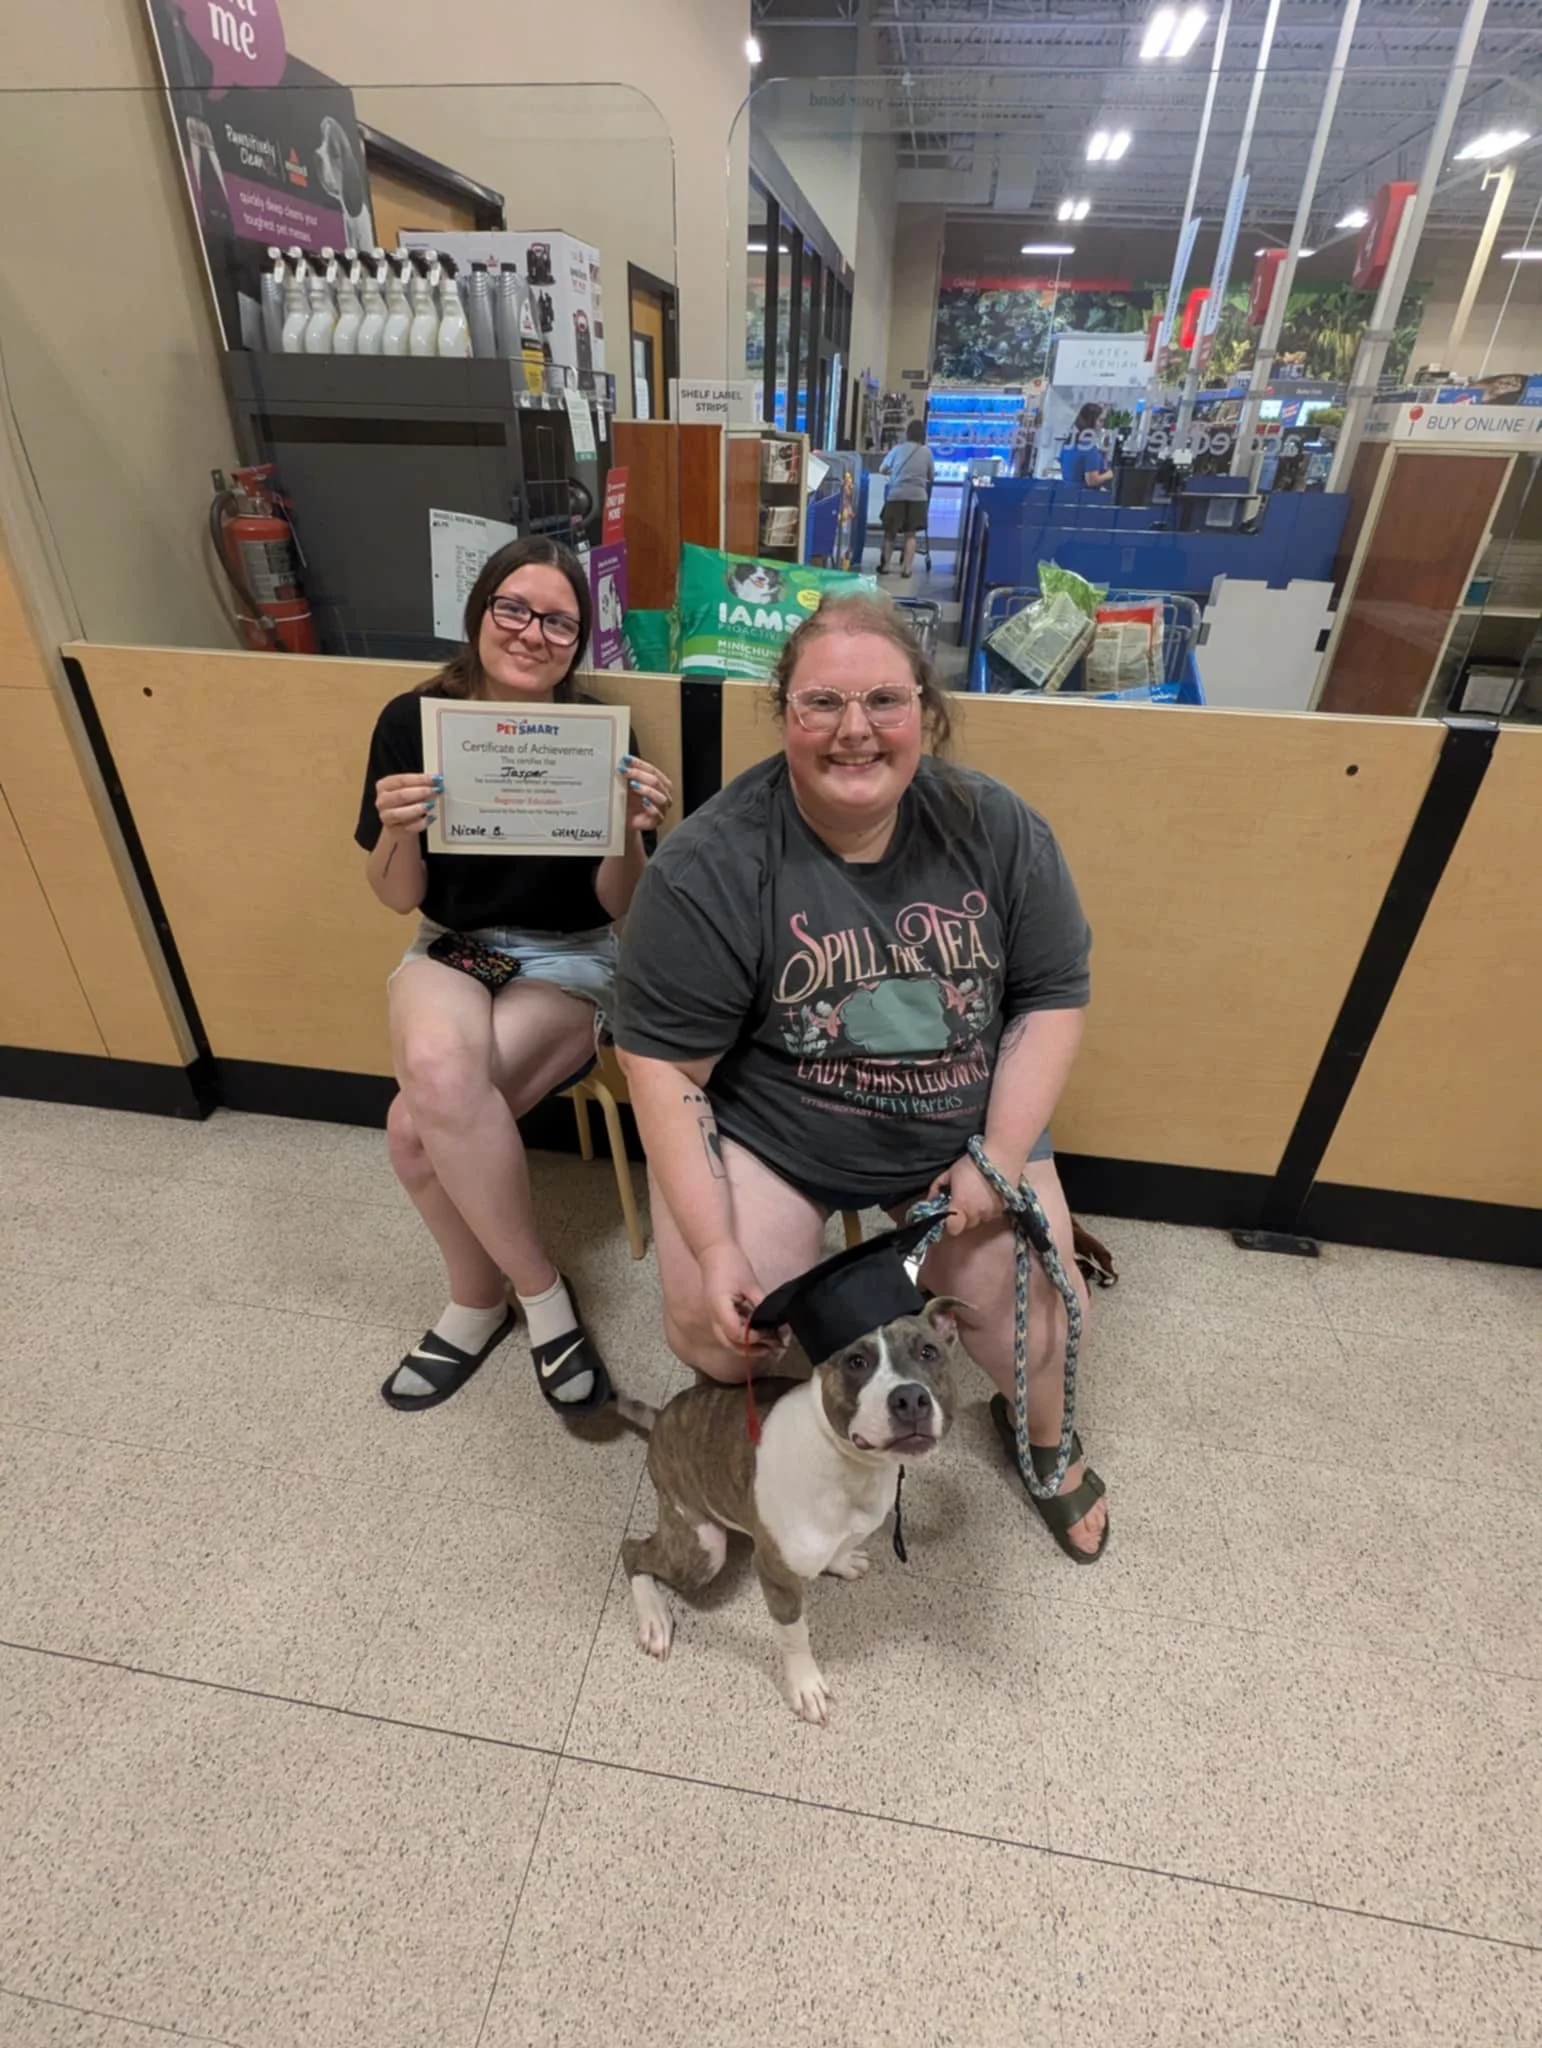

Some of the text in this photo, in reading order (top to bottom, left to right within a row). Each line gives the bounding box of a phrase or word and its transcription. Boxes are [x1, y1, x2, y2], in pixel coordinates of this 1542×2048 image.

[207, 1, 257, 60] me
[681, 389, 744, 401] SHELF LABEL
[695, 402, 729, 413] STRIPS
[1426, 415, 1462, 431] BUY
[1464, 417, 1525, 432] ONLINE
[718, 602, 803, 634] IAMS
[718, 622, 784, 641] PROACTIV
[496, 721, 559, 735] PETSMART
[461, 740, 595, 757] Certificate of Achievement
[500, 766, 549, 781] Jasper
[451, 823, 487, 838] Nicole
[895, 890, 1000, 976] TEA
[885, 943, 932, 973] THE
[797, 1056, 849, 1089] LADY
[911, 1095, 963, 1114] PAPERS
